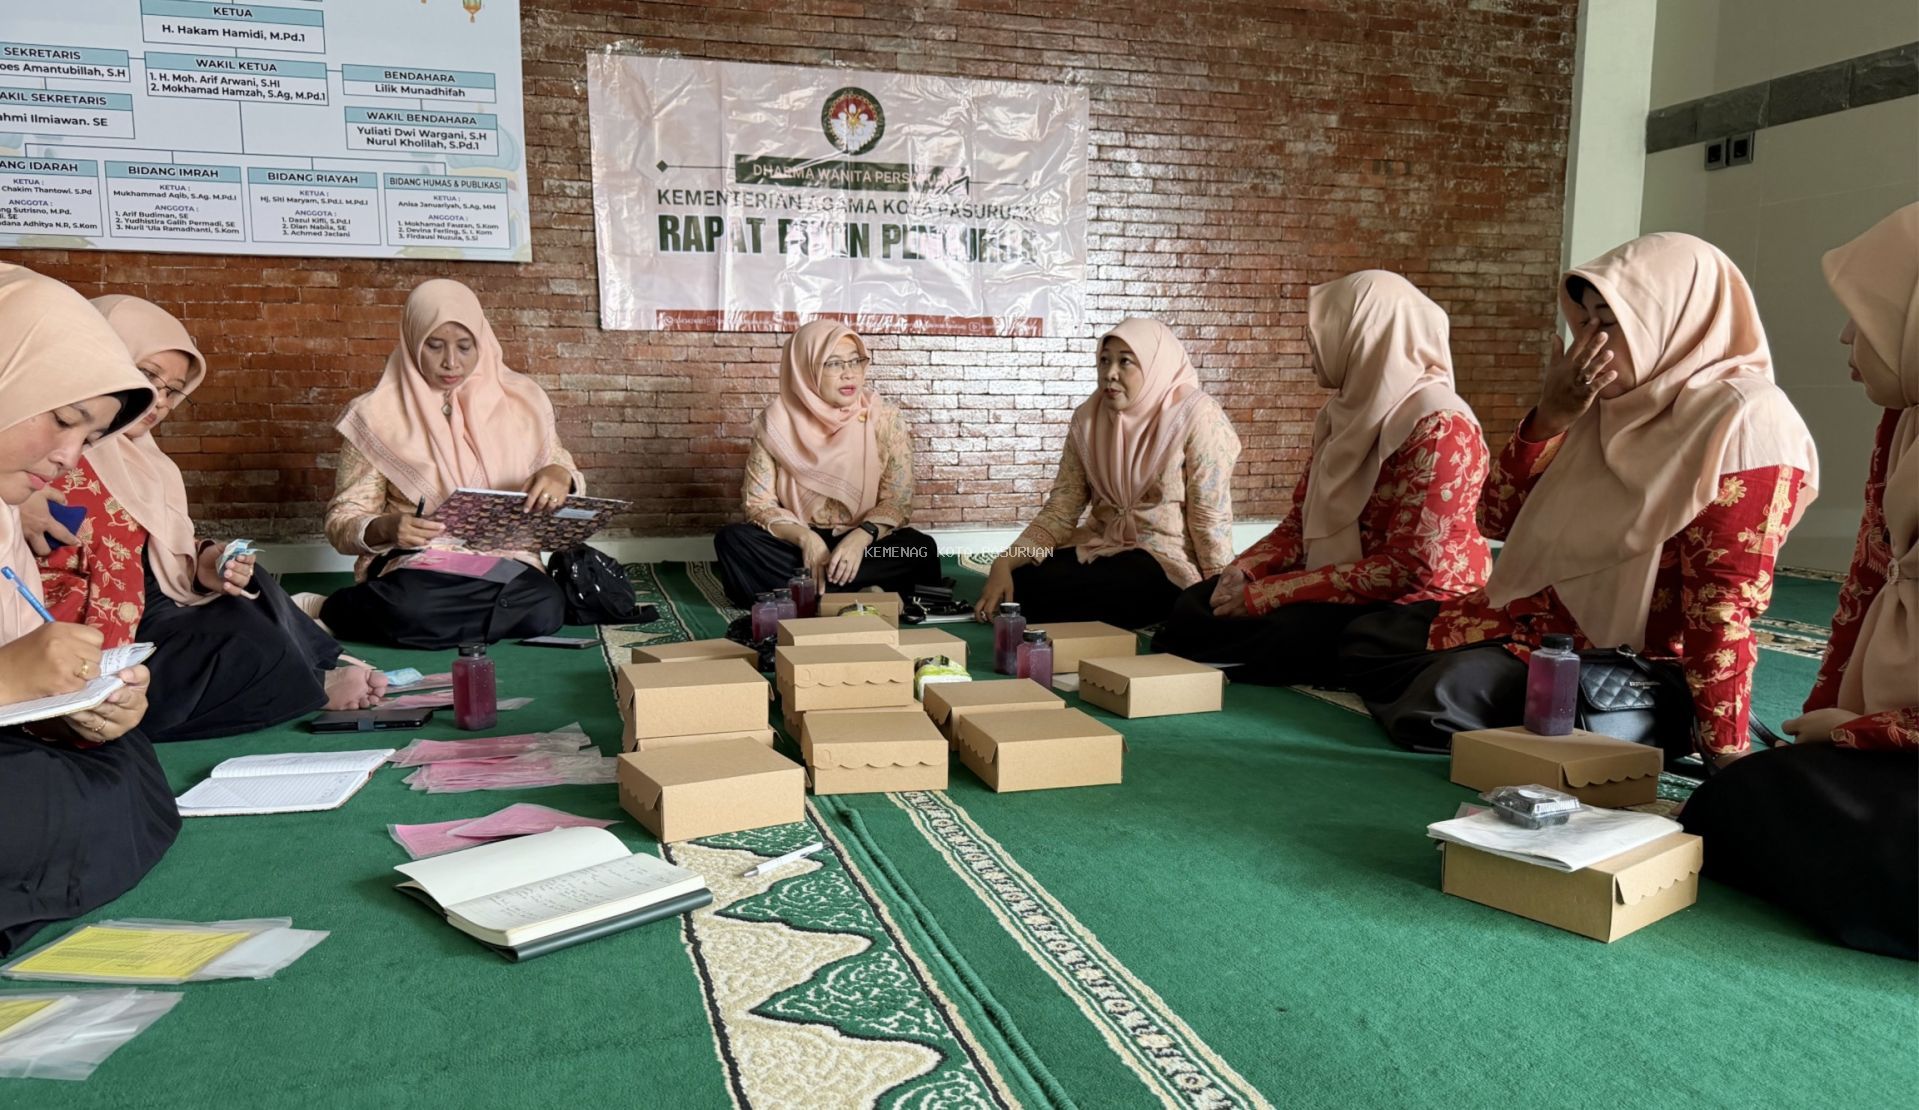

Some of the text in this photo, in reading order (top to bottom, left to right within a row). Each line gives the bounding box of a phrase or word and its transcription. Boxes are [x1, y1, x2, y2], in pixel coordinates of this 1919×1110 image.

[213, 7, 253, 18] KETUA
[162, 24, 174, 34] H.
[177, 25, 219, 36] Hakam
[222, 27, 268, 41] Hamidi,
[4, 46, 81, 60] SEKRETARIS
[23, 63, 104, 77] Amantubillah,
[107, 67, 126, 78] S.H
[196, 59, 277, 72] WAKIL KETUA
[150, 72, 280, 88] 1. H. Moh. Arif Arwani, S.HI
[384, 70, 455, 83] BENDAHARA
[151, 83, 159, 92] 2.
[162, 84, 220, 95] Mokhamad
[222, 86, 266, 98] Hamzah,
[375, 84, 466, 98] Lilik Munadhifah
[0, 91, 107, 106] AKIL SEKRETARIS
[93, 117, 108, 127] SE
[366, 111, 477, 126] WAKIL BENDAHARA
[357, 126, 487, 142] Yuliati Dwi Wargani, S.H
[366, 137, 396, 147] Nurul
[400, 138, 447, 151] Kholilah,
[30, 162, 78, 172] IDARAH
[128, 166, 218, 178] BIDANG IMRAH
[268, 172, 358, 184] BIDANG RIAYAH
[818, 168, 872, 183] WANITA
[390, 177, 502, 190] BIDANG HUMAS & PUBLIKASI
[114, 190, 166, 198] Mukhammad
[155, 204, 194, 212] ANGGOTA
[658, 189, 800, 210] KEMENTERIAN
[884, 199, 932, 216] KOA
[658, 214, 766, 254] RAPAT
